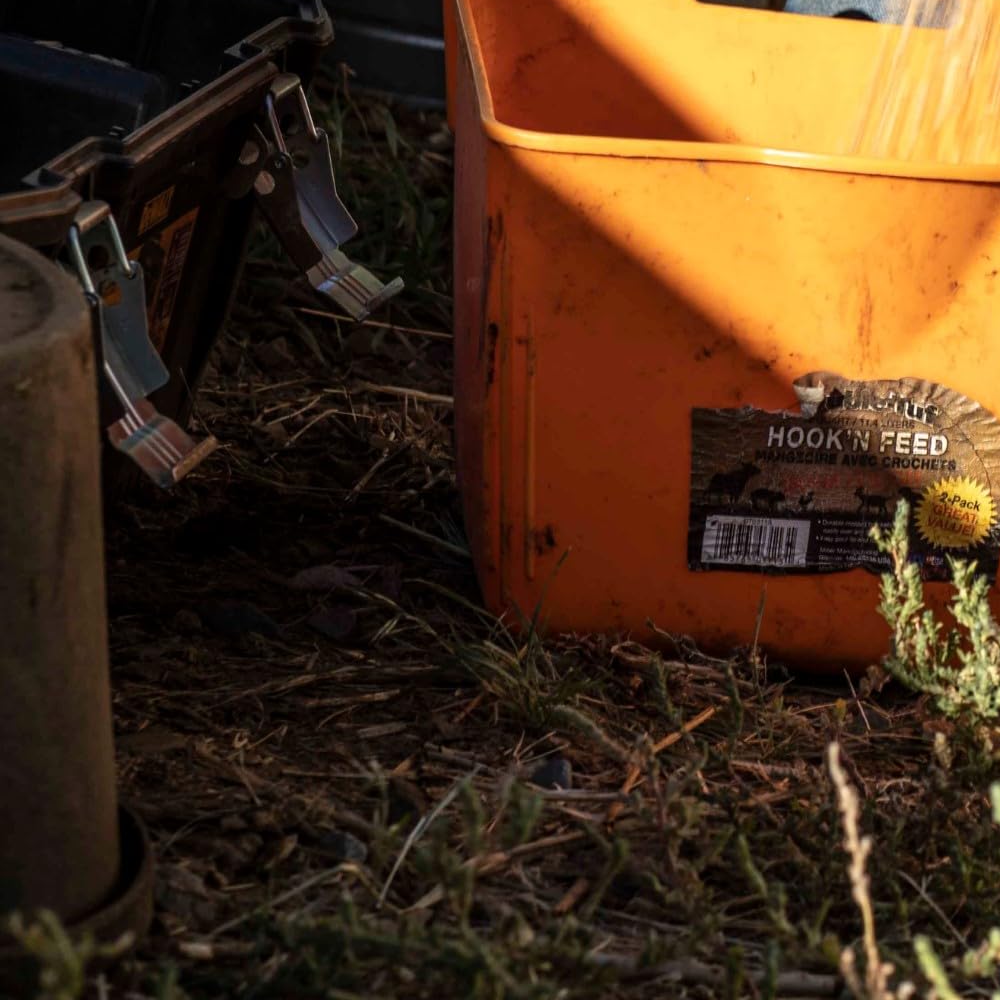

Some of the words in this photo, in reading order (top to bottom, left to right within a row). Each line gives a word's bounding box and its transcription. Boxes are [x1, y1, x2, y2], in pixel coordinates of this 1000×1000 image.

[880, 431, 949, 457] FEED
[882, 454, 957, 471] CROCHETS
[940, 491, 981, 512] 2-Pack
